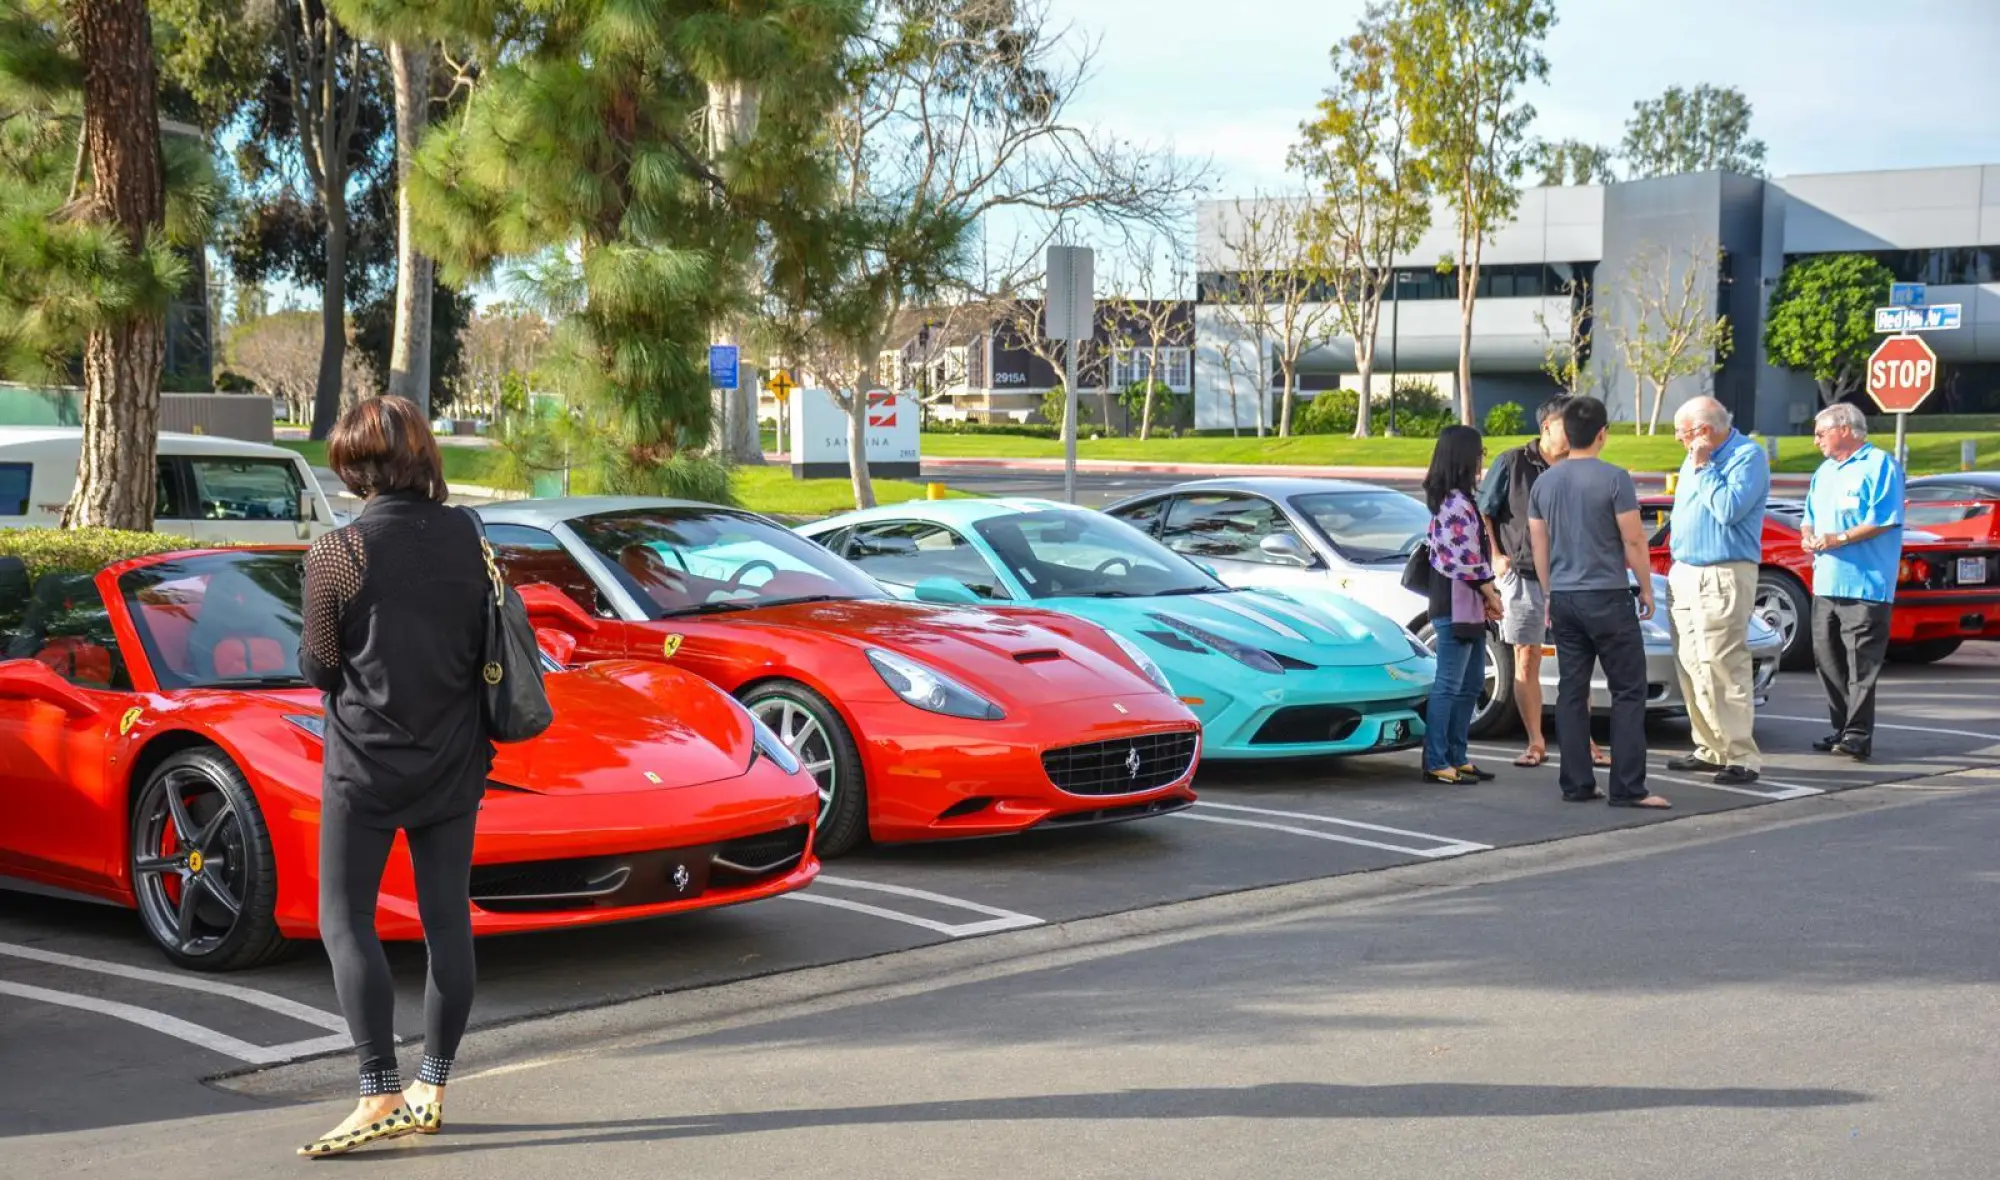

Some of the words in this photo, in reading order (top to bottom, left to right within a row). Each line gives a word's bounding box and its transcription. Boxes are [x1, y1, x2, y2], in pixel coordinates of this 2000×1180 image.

[1879, 310, 1902, 330] Red
[995, 371, 1026, 383] 2915A
[1871, 359, 1931, 389] STOP
